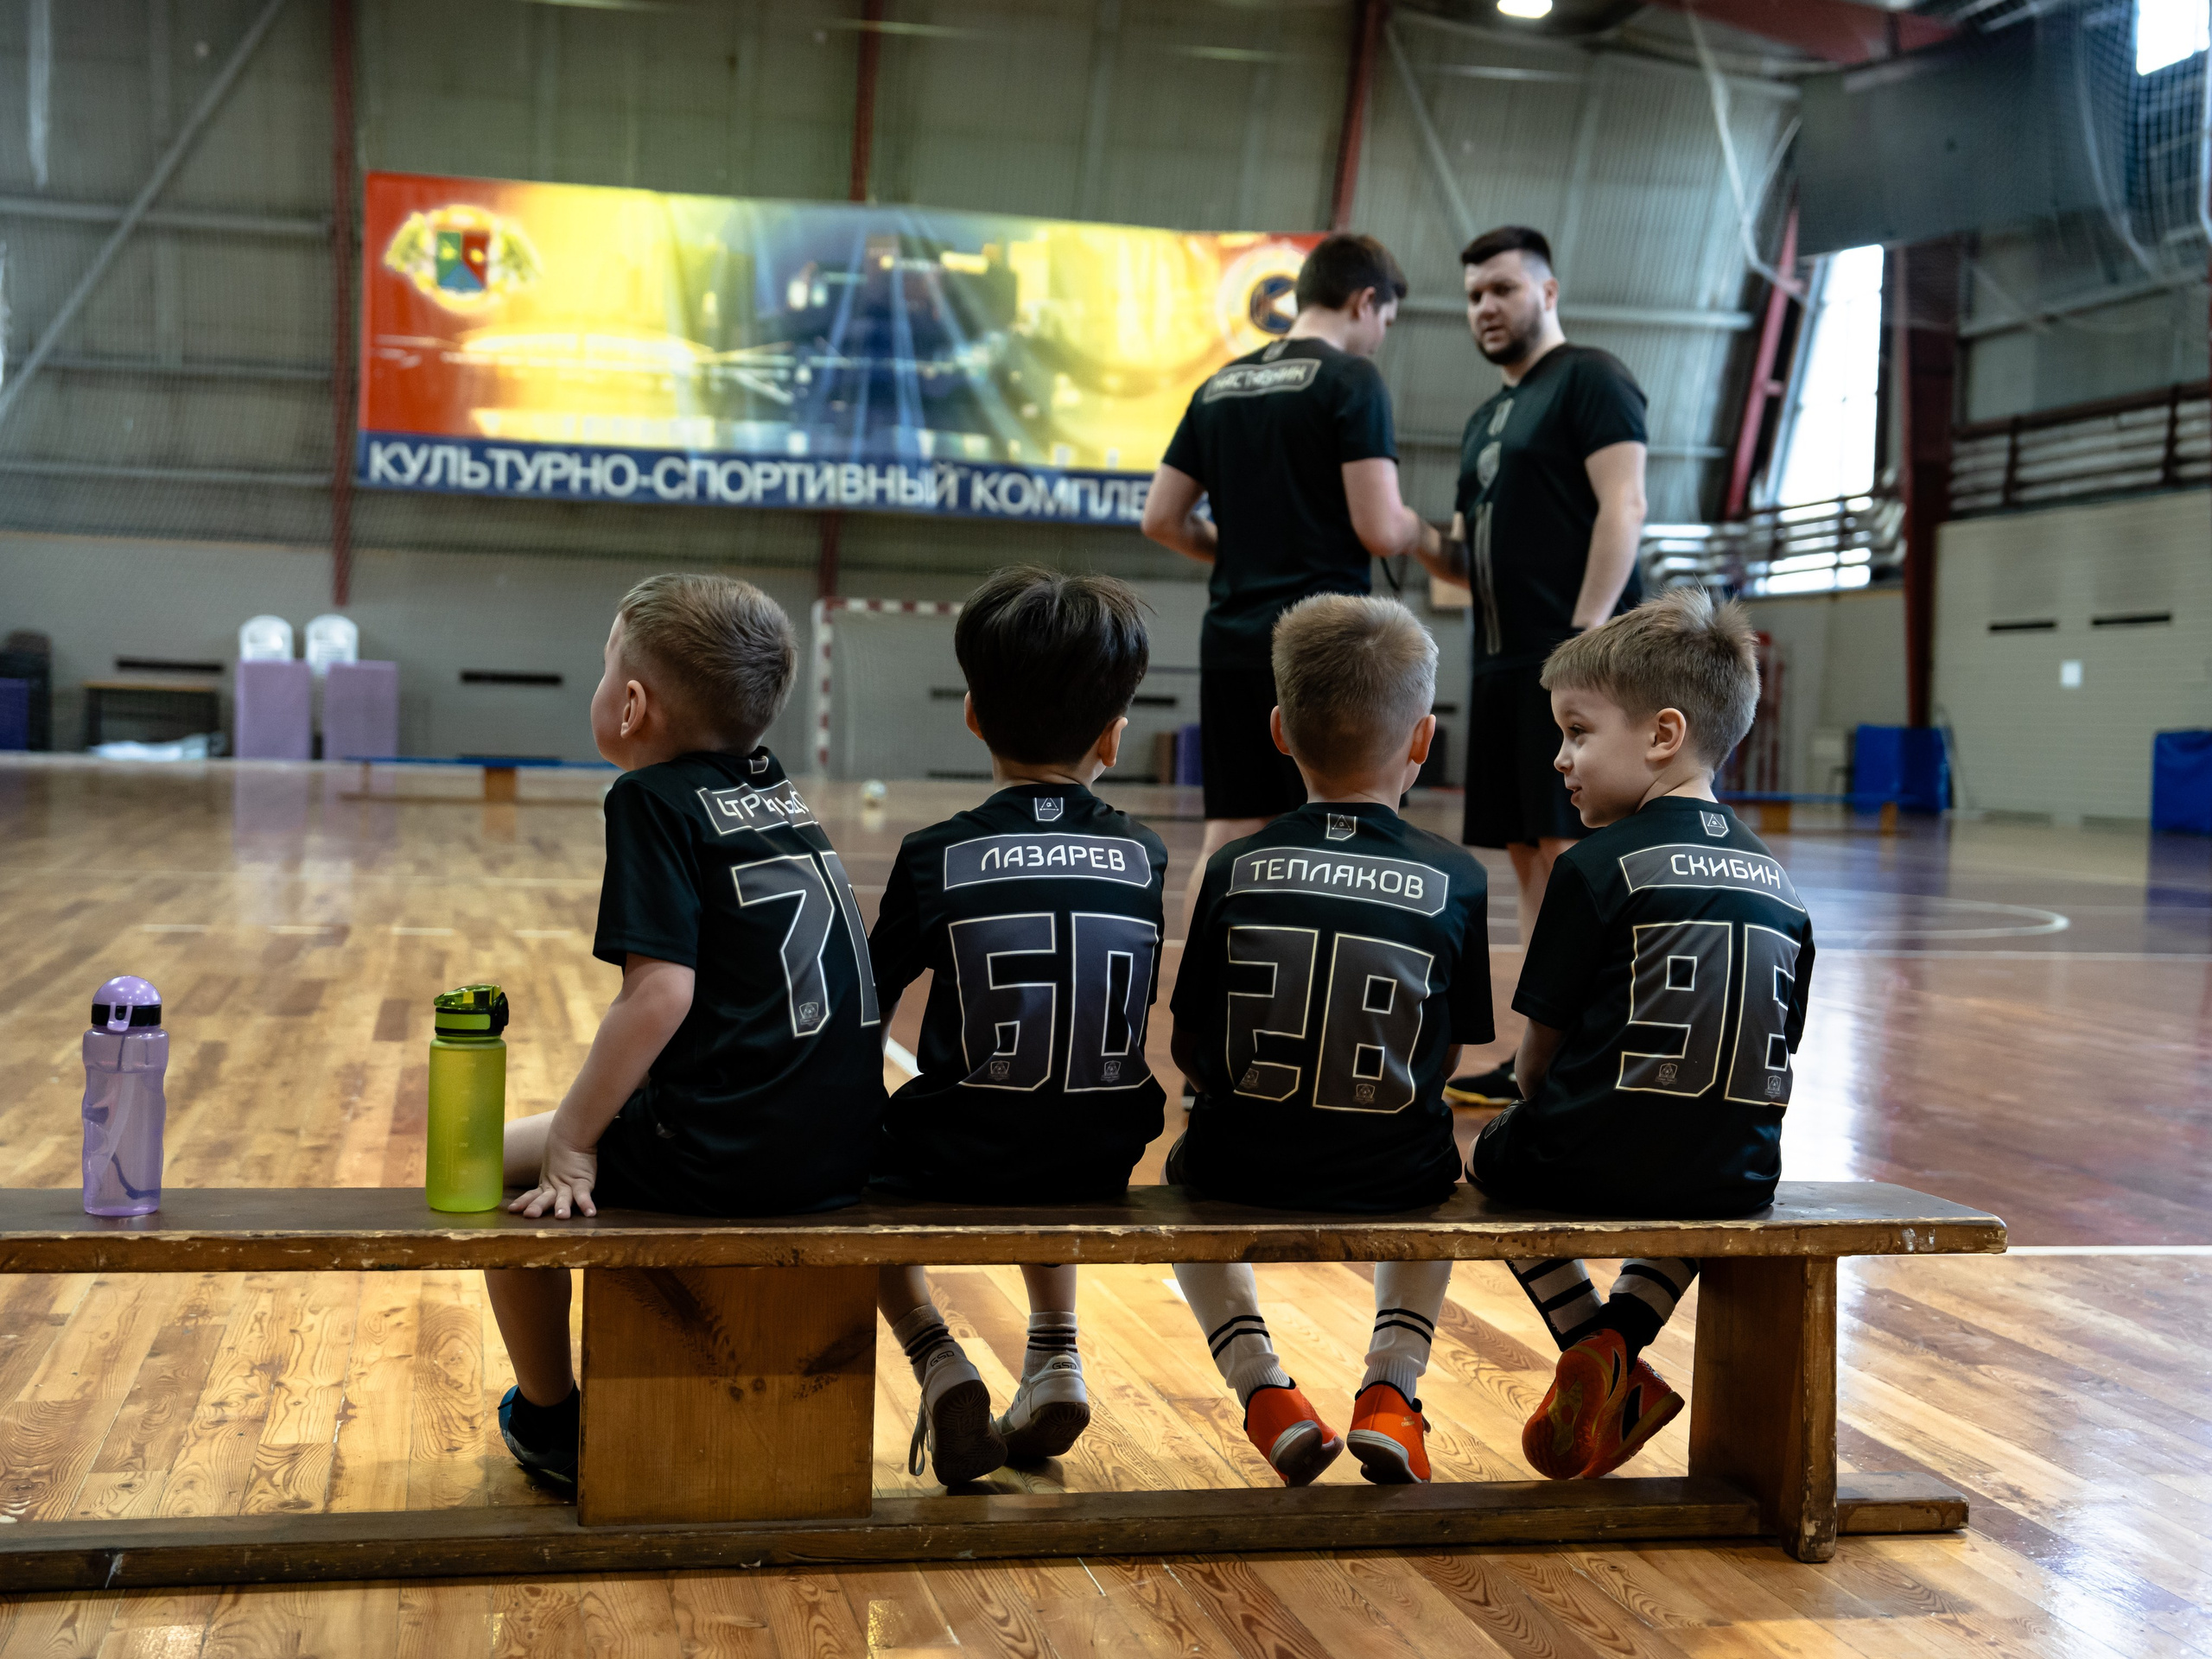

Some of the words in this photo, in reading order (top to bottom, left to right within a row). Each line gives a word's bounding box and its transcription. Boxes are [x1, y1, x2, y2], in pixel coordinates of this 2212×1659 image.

[370, 442, 959, 510] КУЛЬТУРНО-СПОРТИВНЫЙ
[970, 471, 1152, 520] КОМПЛЕ
[982, 844, 1126, 872] ЛАЗАРЕВ
[1249, 858, 1424, 899] ТЕПЛЯКОВ
[1670, 854, 1781, 889] СКИБИН
[948, 911, 1160, 1093] 60
[1225, 925, 1436, 1115] 28
